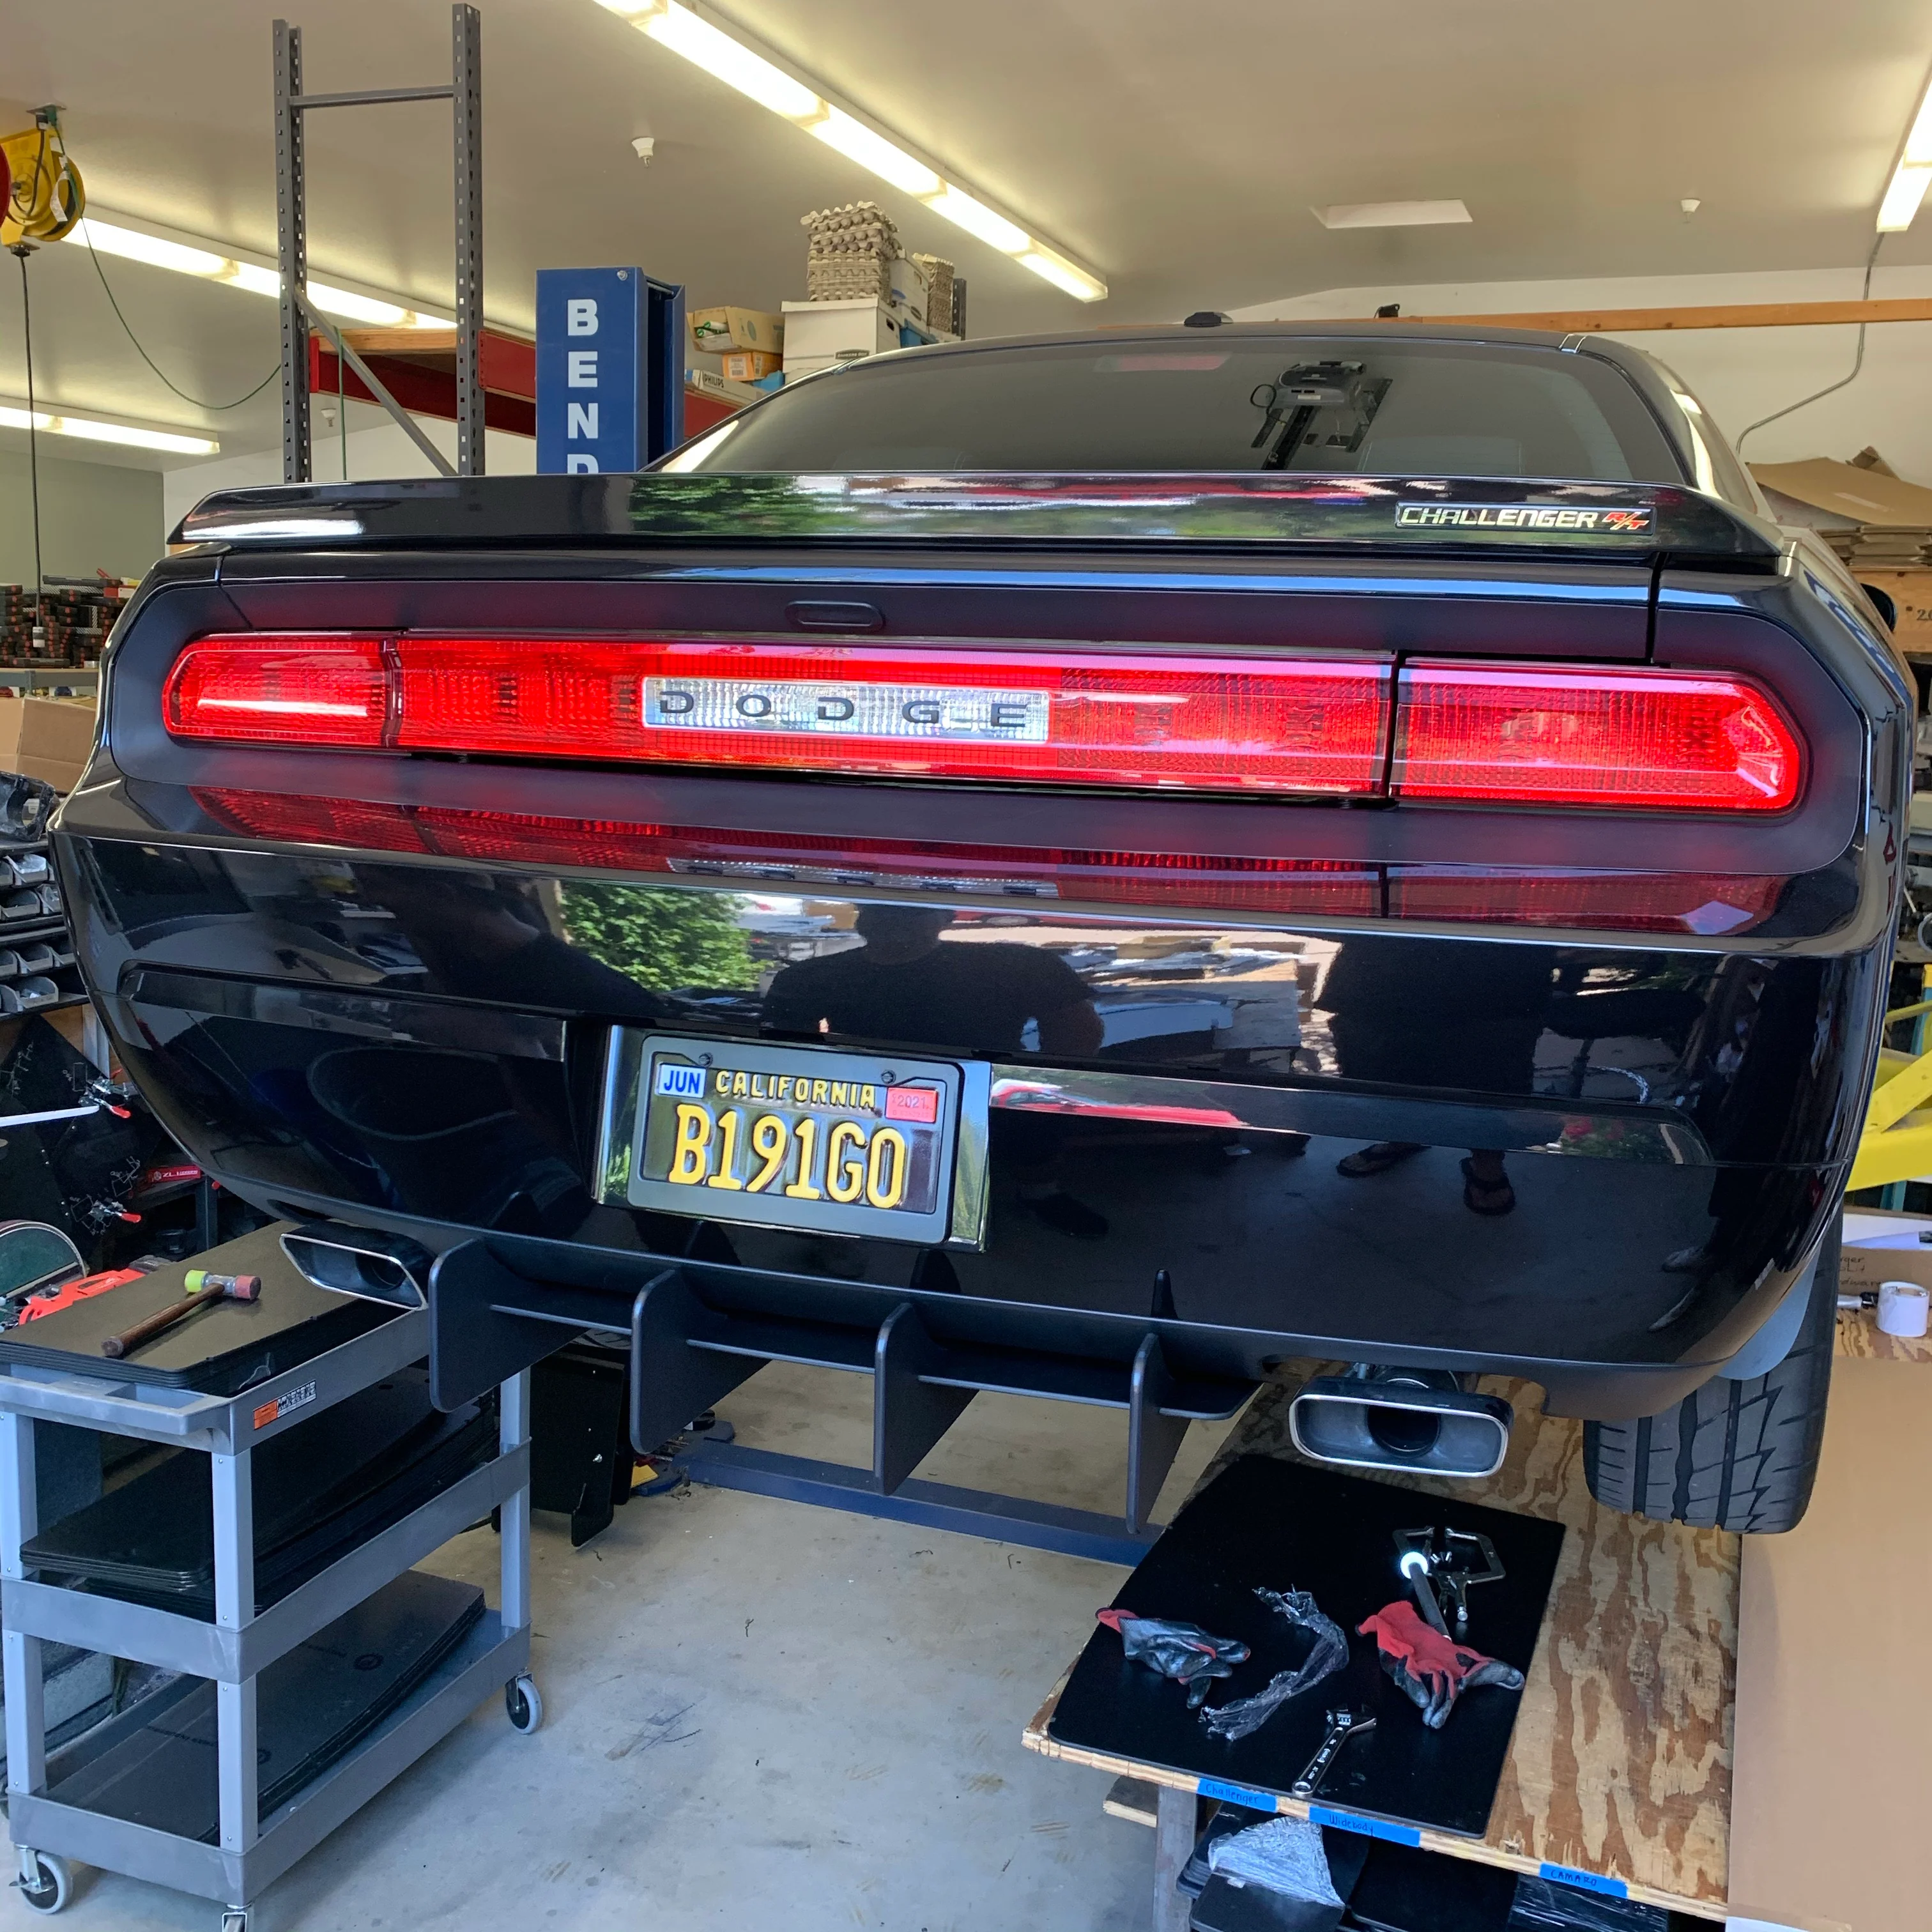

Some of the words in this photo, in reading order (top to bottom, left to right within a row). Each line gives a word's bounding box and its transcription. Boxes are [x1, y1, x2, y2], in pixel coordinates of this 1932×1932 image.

[704, 373, 724, 388] PHILIPS
[1400, 507, 1598, 528] CHALLENGER
[1603, 512, 1650, 530] R/T
[659, 690, 1027, 728] DODGE
[664, 1070, 701, 1094] JUN
[716, 1070, 875, 1108] CALIFORNIA
[897, 1094, 926, 1109] 2021
[1206, 1783, 1260, 1805] Challenger
[1329, 1814, 1374, 1836] Widebody
[1551, 1869, 1597, 1887] CAMARO
